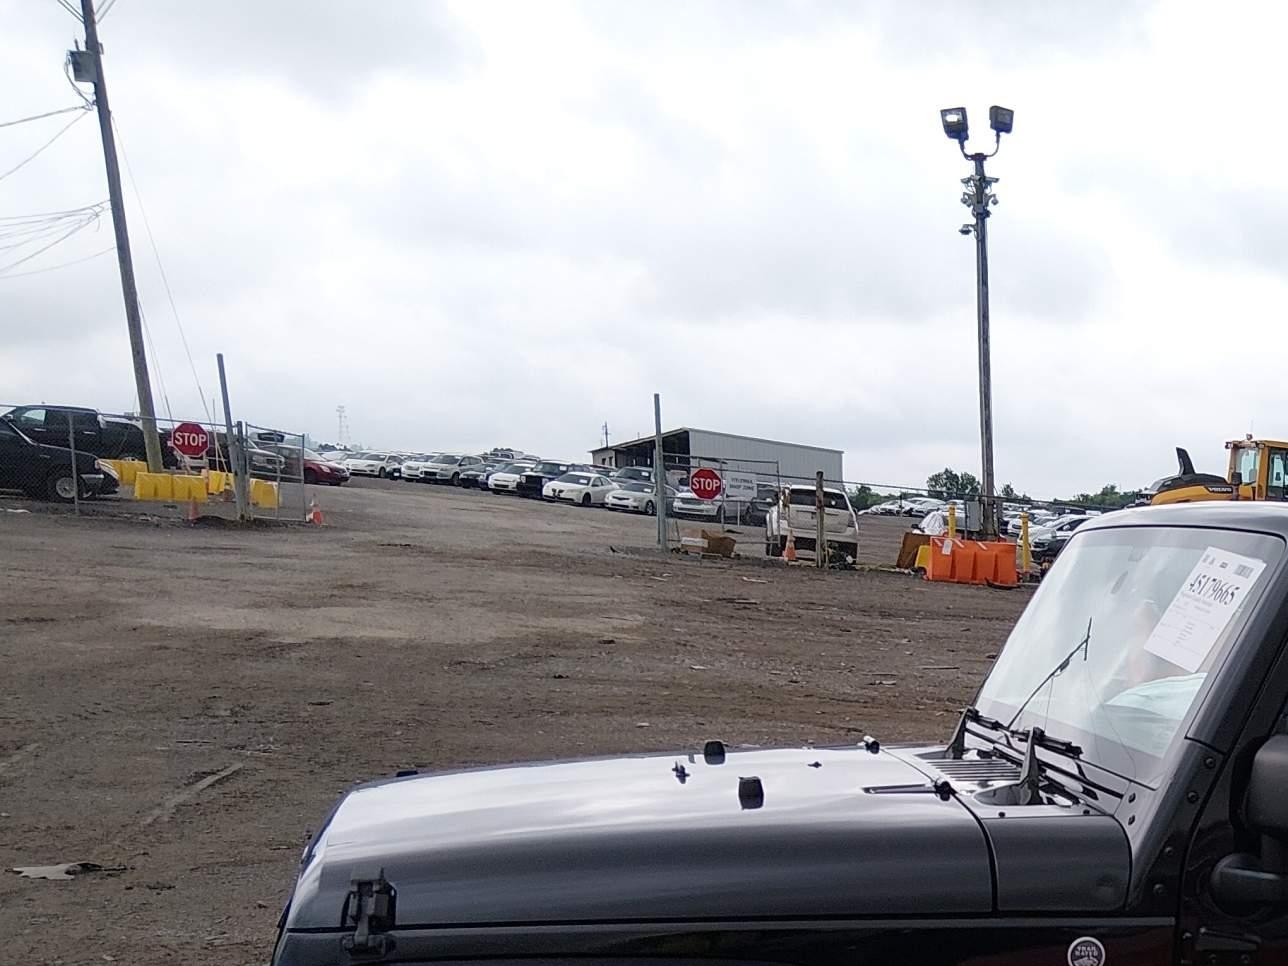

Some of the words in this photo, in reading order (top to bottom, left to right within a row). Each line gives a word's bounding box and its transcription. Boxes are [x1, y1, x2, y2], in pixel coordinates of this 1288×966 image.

[174, 431, 206, 447] STOP
[692, 477, 721, 491] STOP
[1189, 572, 1241, 606] 45179665
